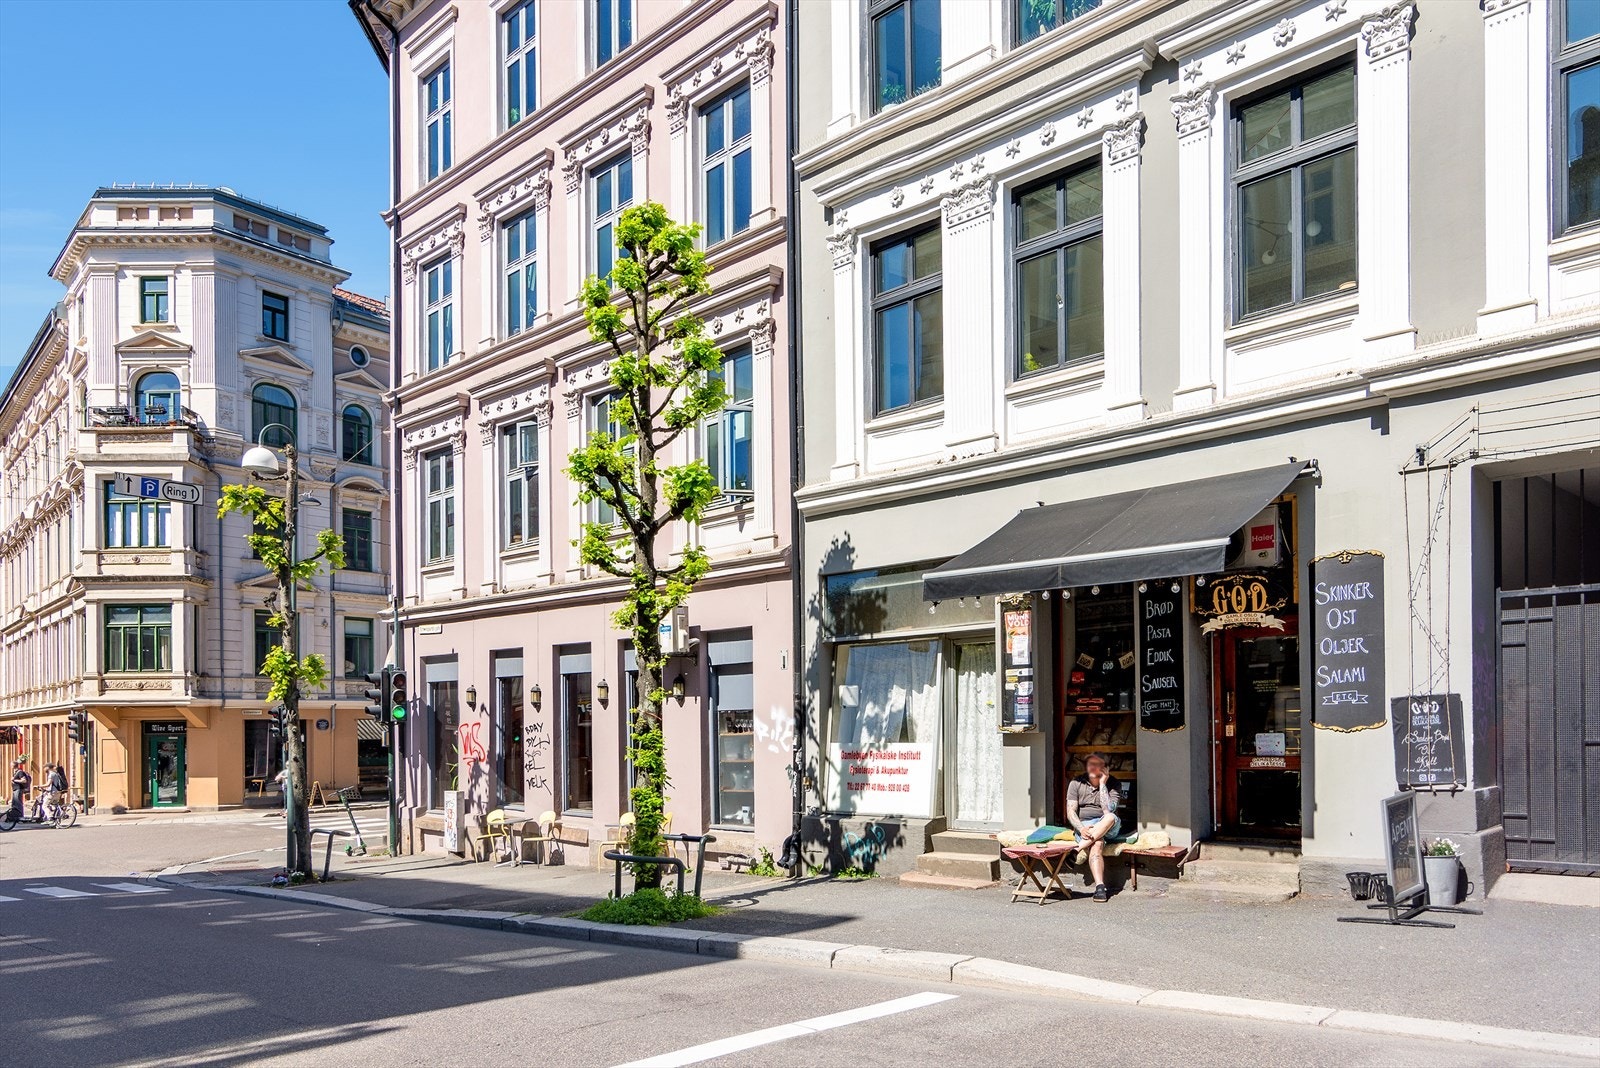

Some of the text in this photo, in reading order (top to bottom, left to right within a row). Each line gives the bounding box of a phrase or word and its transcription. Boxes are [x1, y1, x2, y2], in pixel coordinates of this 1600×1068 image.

[167, 486, 187, 500] Ring
[190, 488, 195, 500] 1
[1251, 534, 1274, 542] Haier
[1315, 582, 1374, 606] SKINKER
[1146, 599, 1174, 619] BRØD
[1327, 607, 1357, 630] OST
[1147, 624, 1172, 641] PASTA
[1320, 637, 1369, 656] OLJER
[1147, 647, 1175, 666] EDDIK
[1142, 674, 1178, 693] SAUSER
[1317, 665, 1366, 688] SALAMI
[876, 766, 880, 774] &
[881, 766, 908, 776] Akupunktur
